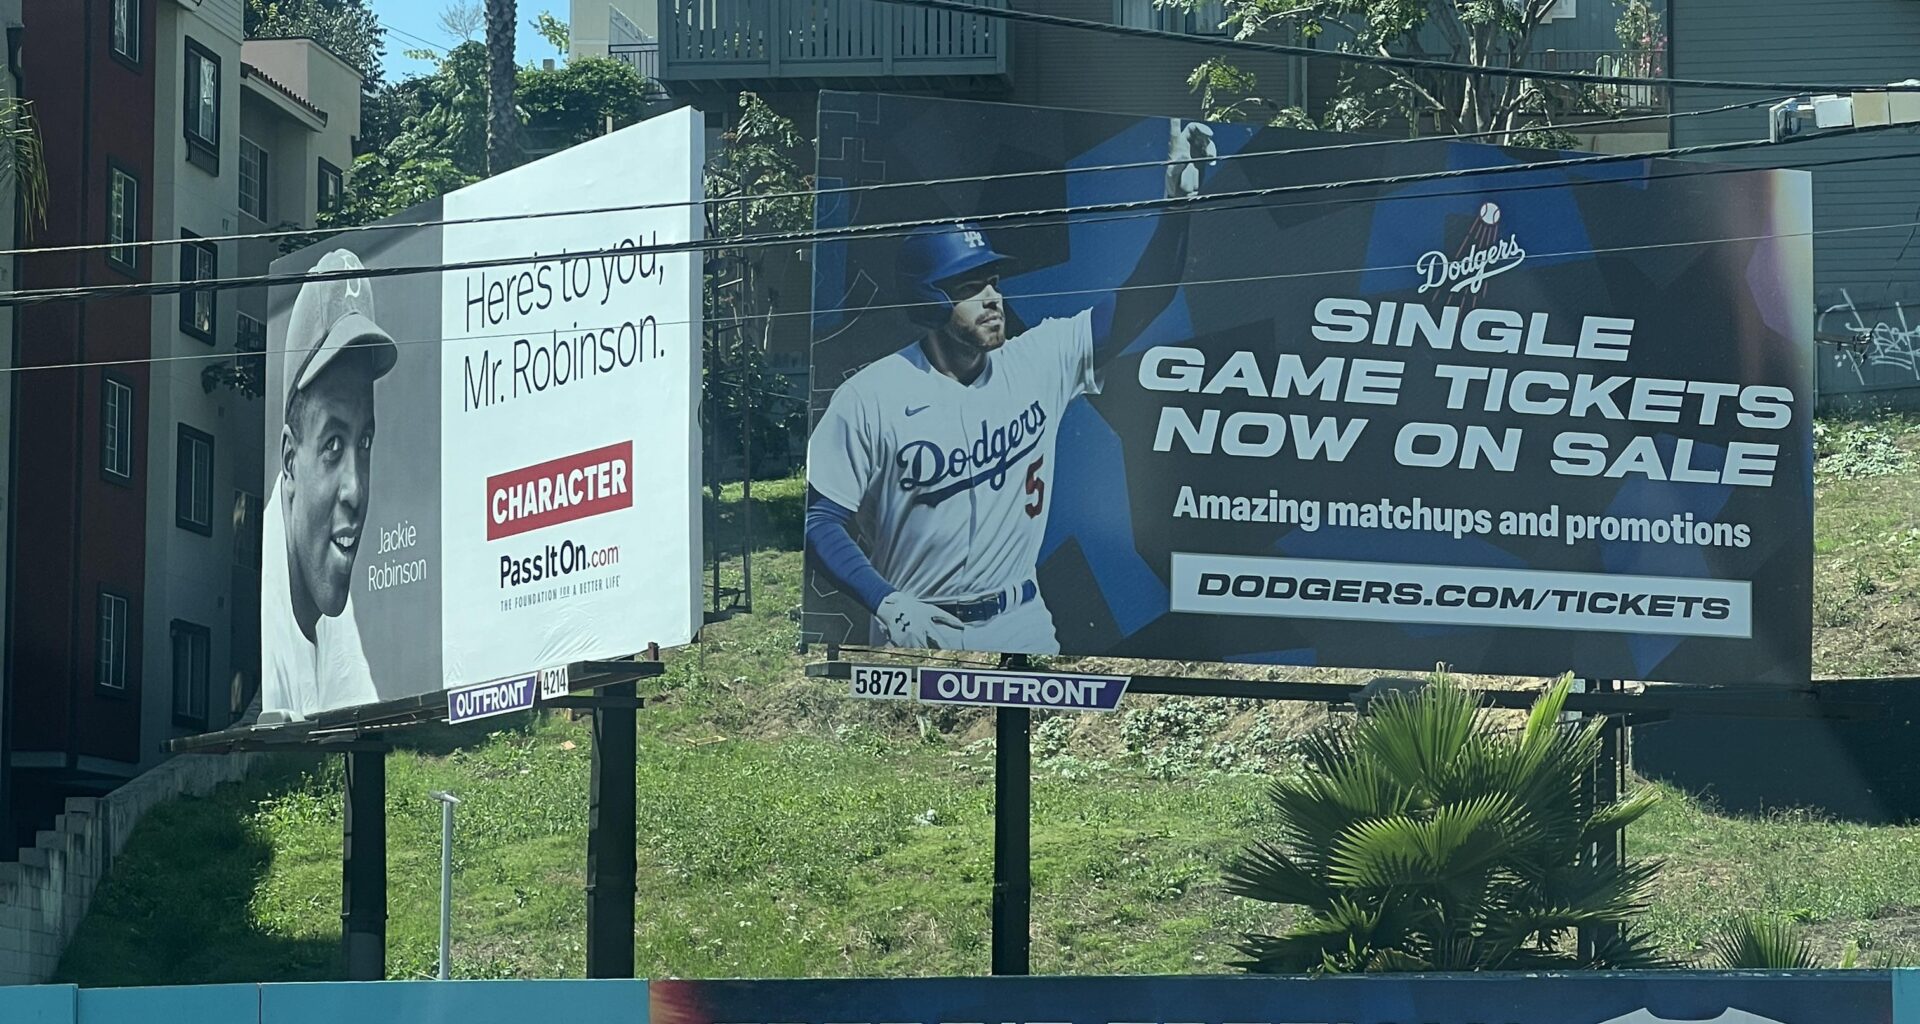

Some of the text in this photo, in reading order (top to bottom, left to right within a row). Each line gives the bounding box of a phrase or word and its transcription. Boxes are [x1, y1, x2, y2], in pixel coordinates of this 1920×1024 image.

[466, 230, 664, 333] Here's to you,
[1416, 233, 1526, 294] Dodgers
[1311, 297, 1635, 362] SINGLE
[464, 314, 665, 413] Mr. Robinson.
[1138, 345, 1794, 430] GAME TICKETS
[897, 400, 1047, 509] Dodgers
[1153, 406, 1780, 487] NOW ON SALE
[491, 459, 628, 525] CHARACTER
[1024, 454, 1045, 520] 5
[1172, 485, 1751, 548] Amazing matchups and promotions
[377, 520, 417, 555] Jackie
[368, 558, 427, 592] Robinson
[500, 598, 512, 612] THE
[514, 588, 558, 609] FOUNDATION
[579, 578, 603, 595] BETTER
[605, 575, 620, 590] LIFE
[1197, 572, 1731, 620] DODGERS.COM/TICKETS
[456, 680, 528, 718] OUTFRONT
[543, 667, 566, 696] 4214
[855, 669, 908, 696] 5872
[937, 673, 1107, 706] OUTFRONT
